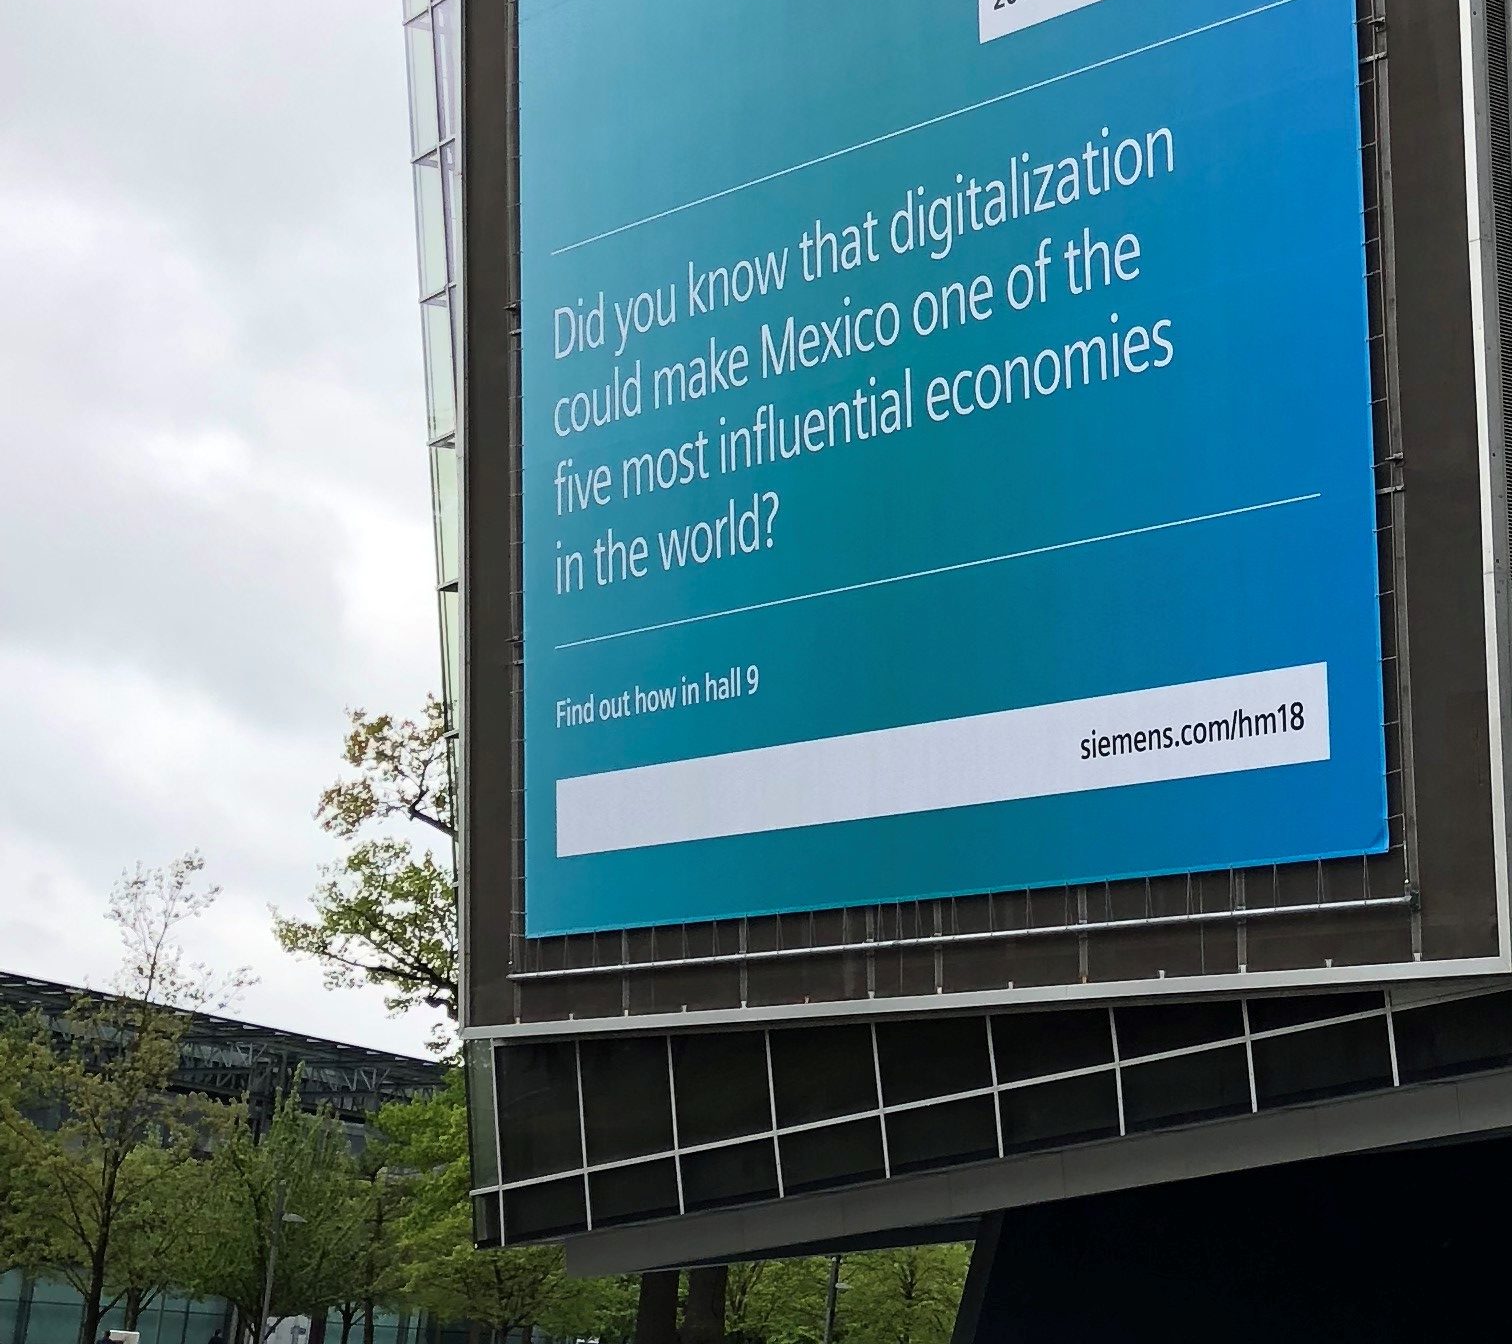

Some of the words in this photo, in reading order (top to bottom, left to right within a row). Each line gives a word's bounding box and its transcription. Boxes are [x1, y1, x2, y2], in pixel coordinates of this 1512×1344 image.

[554, 291, 605, 360] Did
[614, 284, 677, 357] you
[688, 246, 789, 317] know
[799, 210, 880, 283] that
[890, 126, 1175, 261] digitalization
[554, 359, 642, 437] could
[654, 336, 750, 410] make
[761, 296, 900, 379] Mexico
[913, 274, 994, 337] one
[1007, 237, 1053, 311] of
[1064, 227, 1142, 296] the
[554, 458, 613, 516] five
[623, 430, 709, 499] most
[720, 367, 913, 475] influential
[926, 312, 1175, 423] economies
[556, 540, 584, 595] in
[594, 527, 649, 586] the
[658, 491, 780, 571] world?
[556, 693, 595, 728] Find
[599, 690, 631, 721] out
[635, 685, 677, 715] how
[681, 675, 700, 706] in
[705, 666, 741, 703] hall
[746, 664, 760, 695] 9
[1080, 701, 1305, 760] siemens.com/hm18
